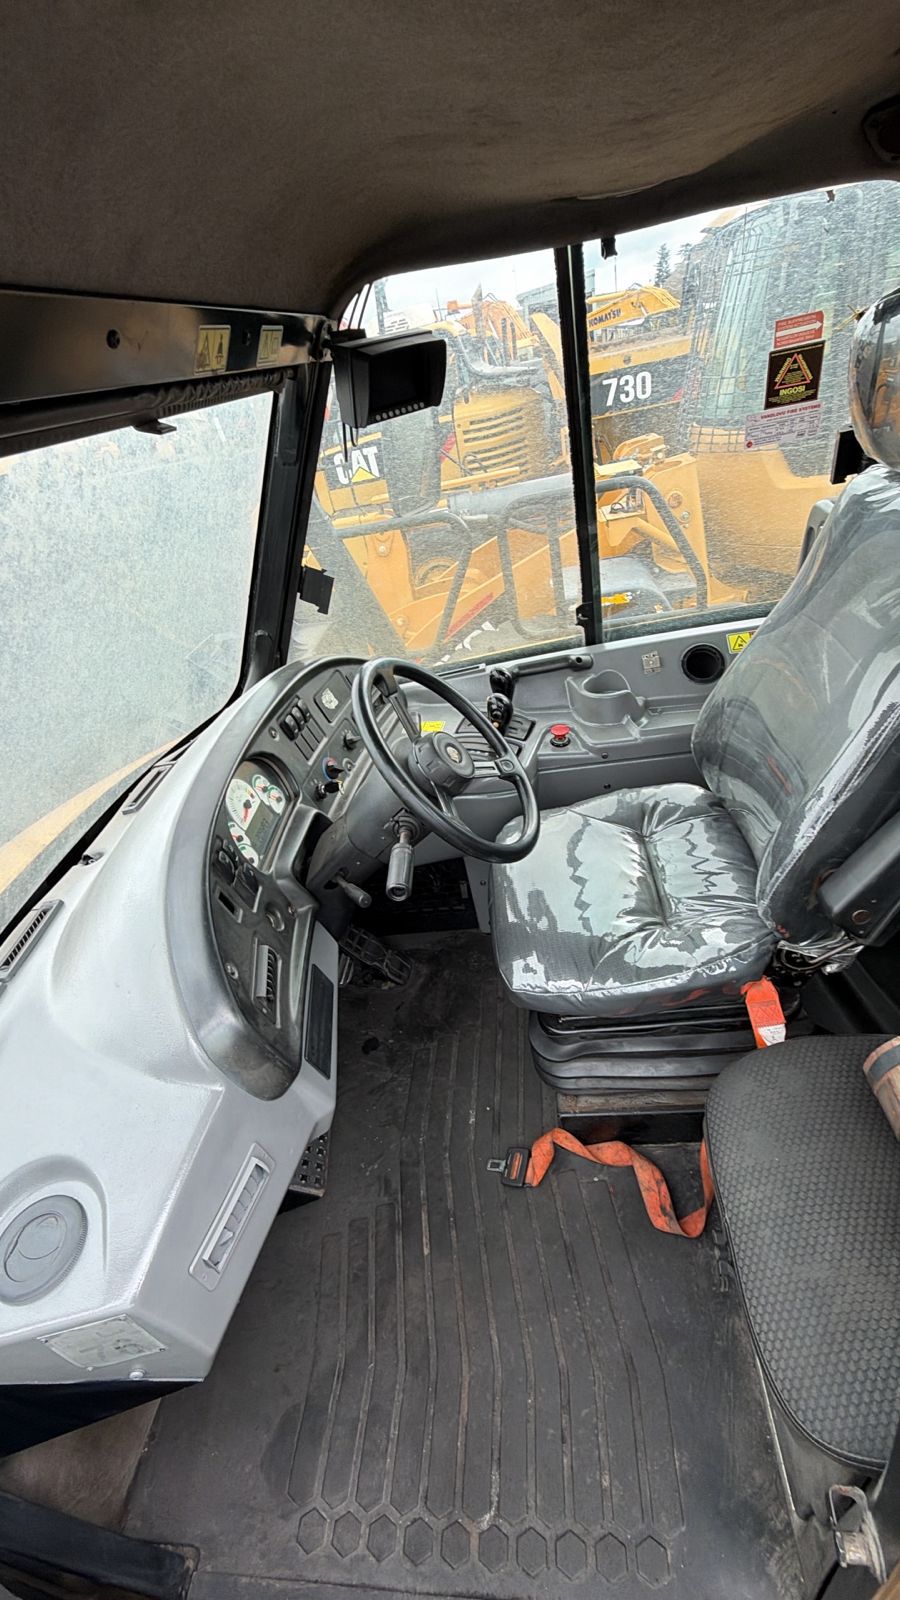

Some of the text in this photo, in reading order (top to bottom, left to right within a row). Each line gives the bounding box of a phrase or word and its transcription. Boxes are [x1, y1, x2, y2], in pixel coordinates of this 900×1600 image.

[588, 308, 622, 328] KOMATSU
[602, 371, 652, 407] 730
[333, 446, 380, 485] CAT
